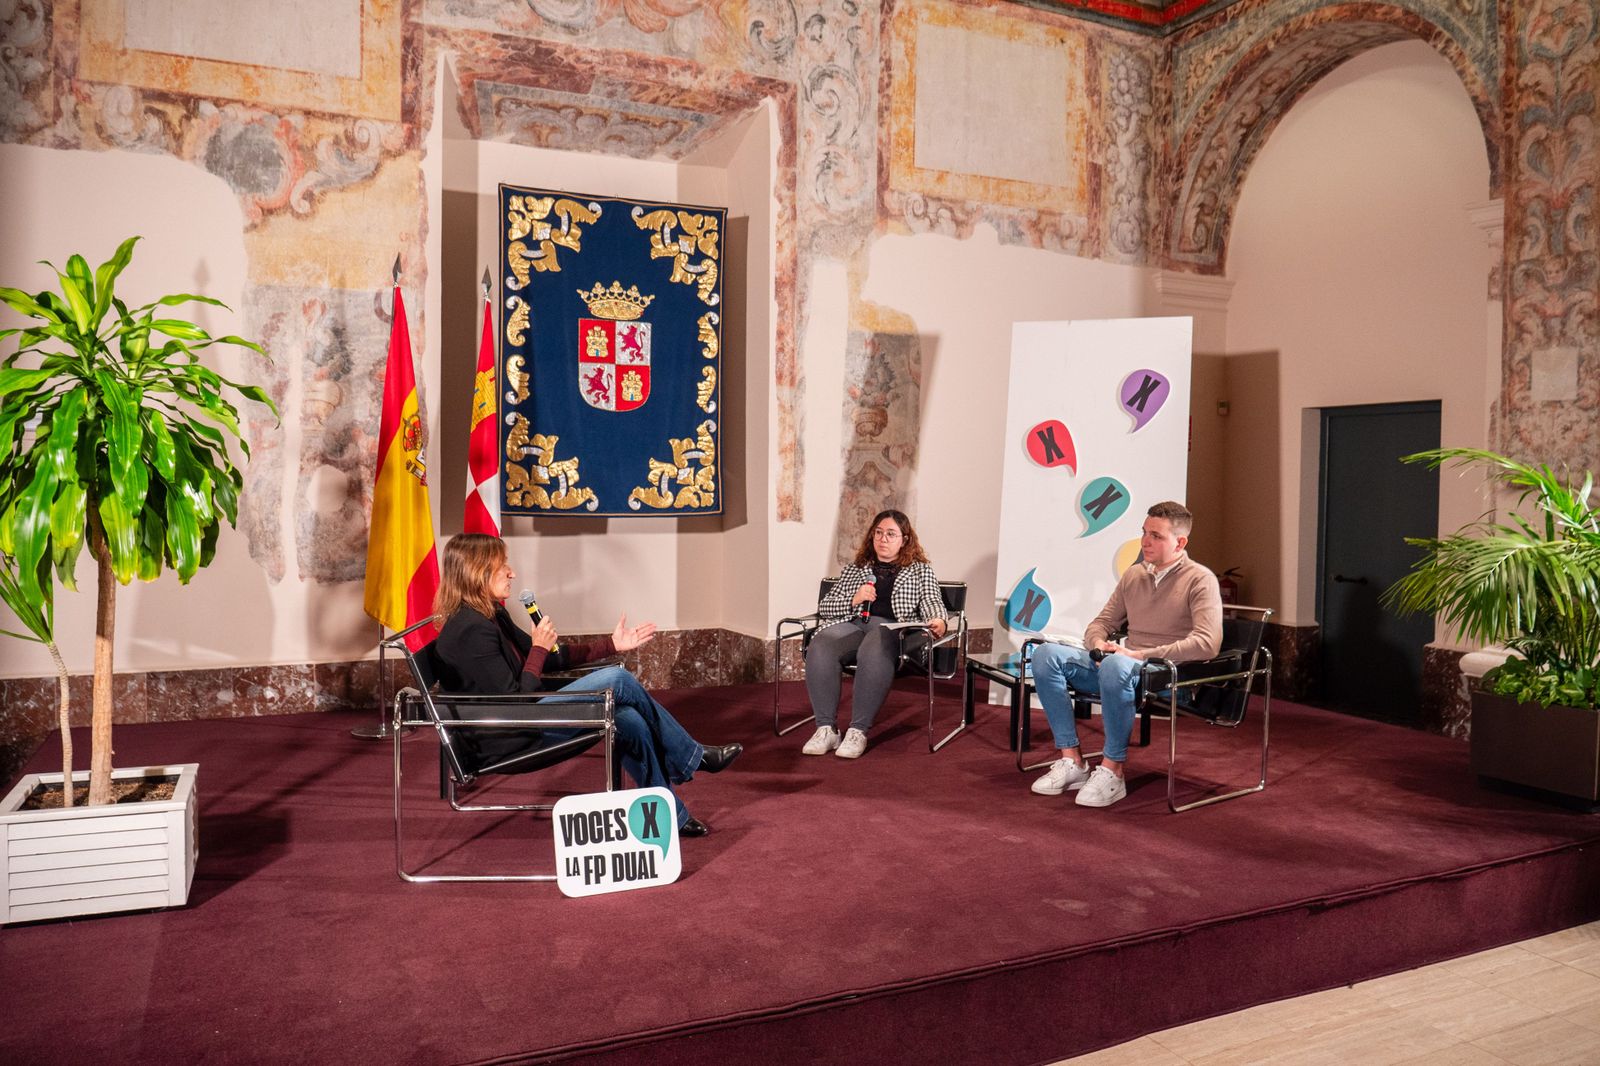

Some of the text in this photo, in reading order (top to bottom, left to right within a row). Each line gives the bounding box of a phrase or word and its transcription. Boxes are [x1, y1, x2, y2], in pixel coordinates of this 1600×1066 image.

[1126, 374, 1161, 413] X
[1036, 426, 1066, 464] X
[1083, 483, 1123, 520] X
[1013, 588, 1046, 628] X
[559, 801, 661, 847] VOCES X
[566, 850, 659, 886] LA FP DUAL
